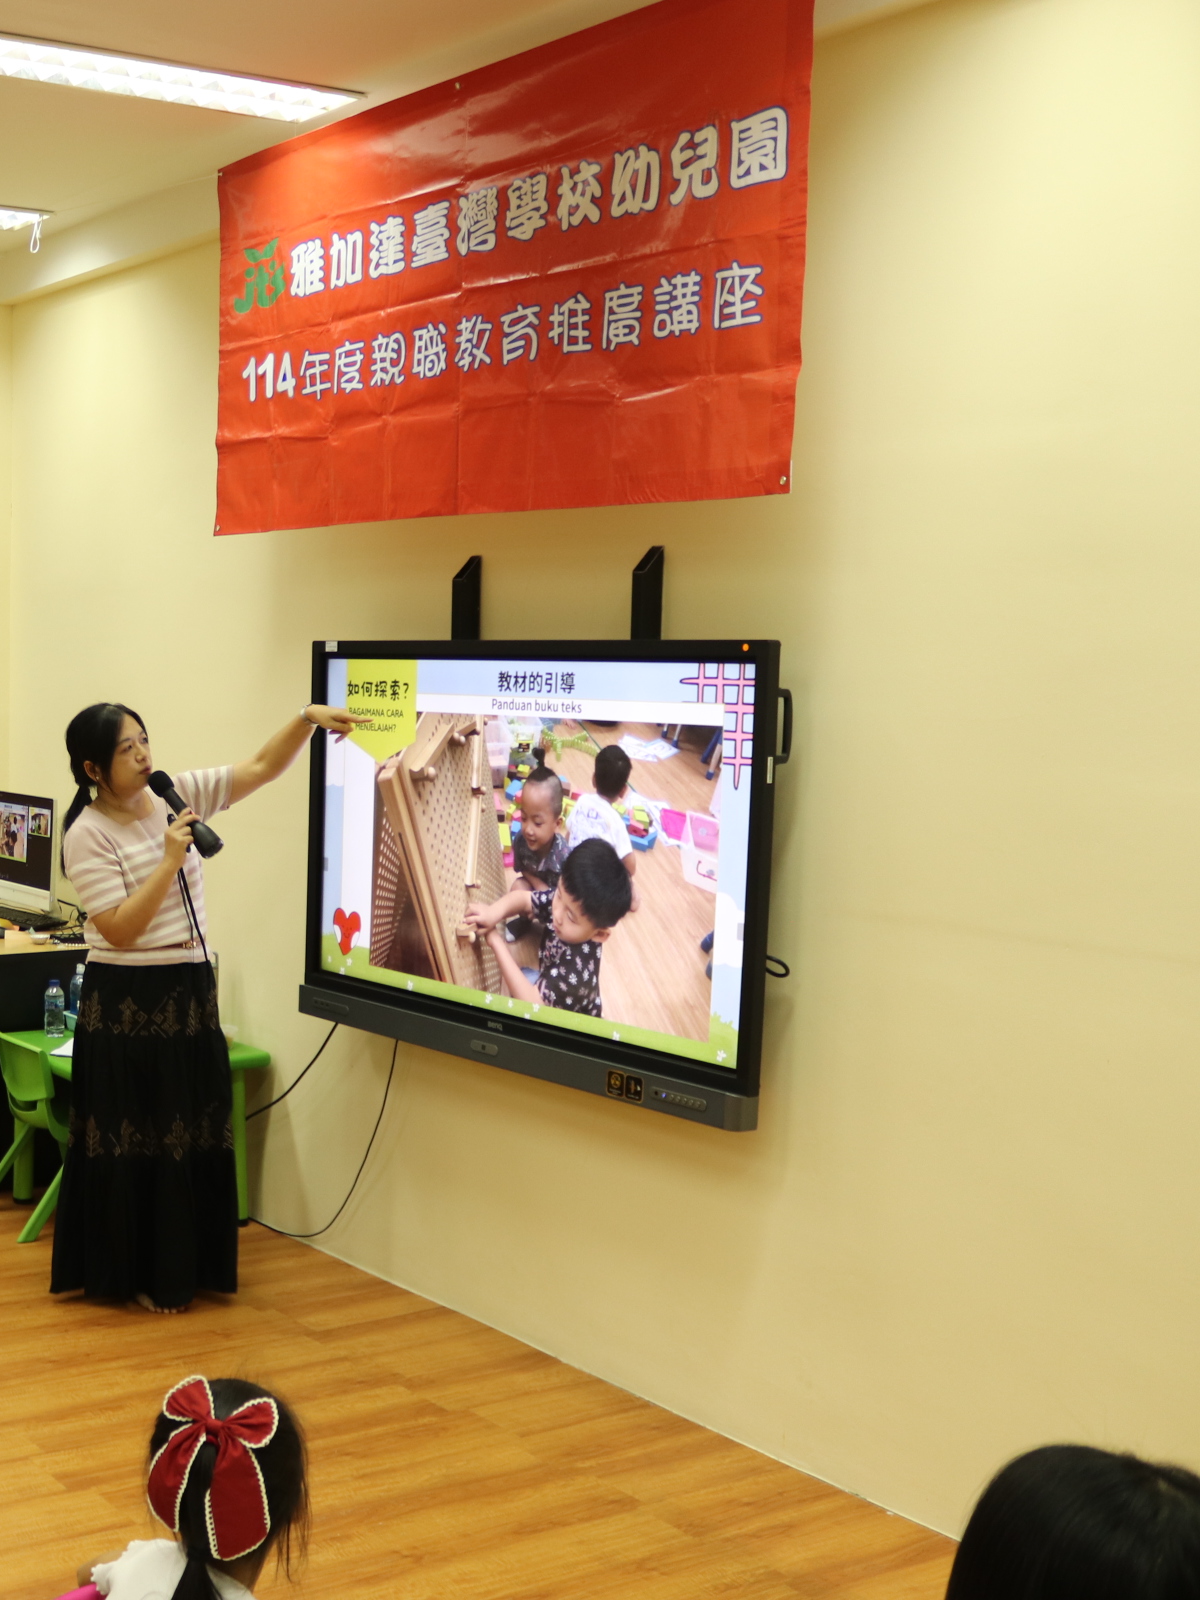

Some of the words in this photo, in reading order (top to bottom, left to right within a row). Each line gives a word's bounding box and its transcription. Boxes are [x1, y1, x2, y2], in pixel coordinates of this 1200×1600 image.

[290, 105, 789, 298] 雅加達臺灣學校幼兒園
[242, 260, 764, 402] 114年度親職教育推廣講座
[497, 671, 575, 694] 教材的引導
[348, 707, 385, 718] BAGAIMANA
[386, 709, 404, 718] CARA
[491, 698, 532, 712] Panduan
[534, 699, 559, 713] buku
[561, 701, 583, 714] teks
[355, 722, 397, 733] MENJELAJAH?
